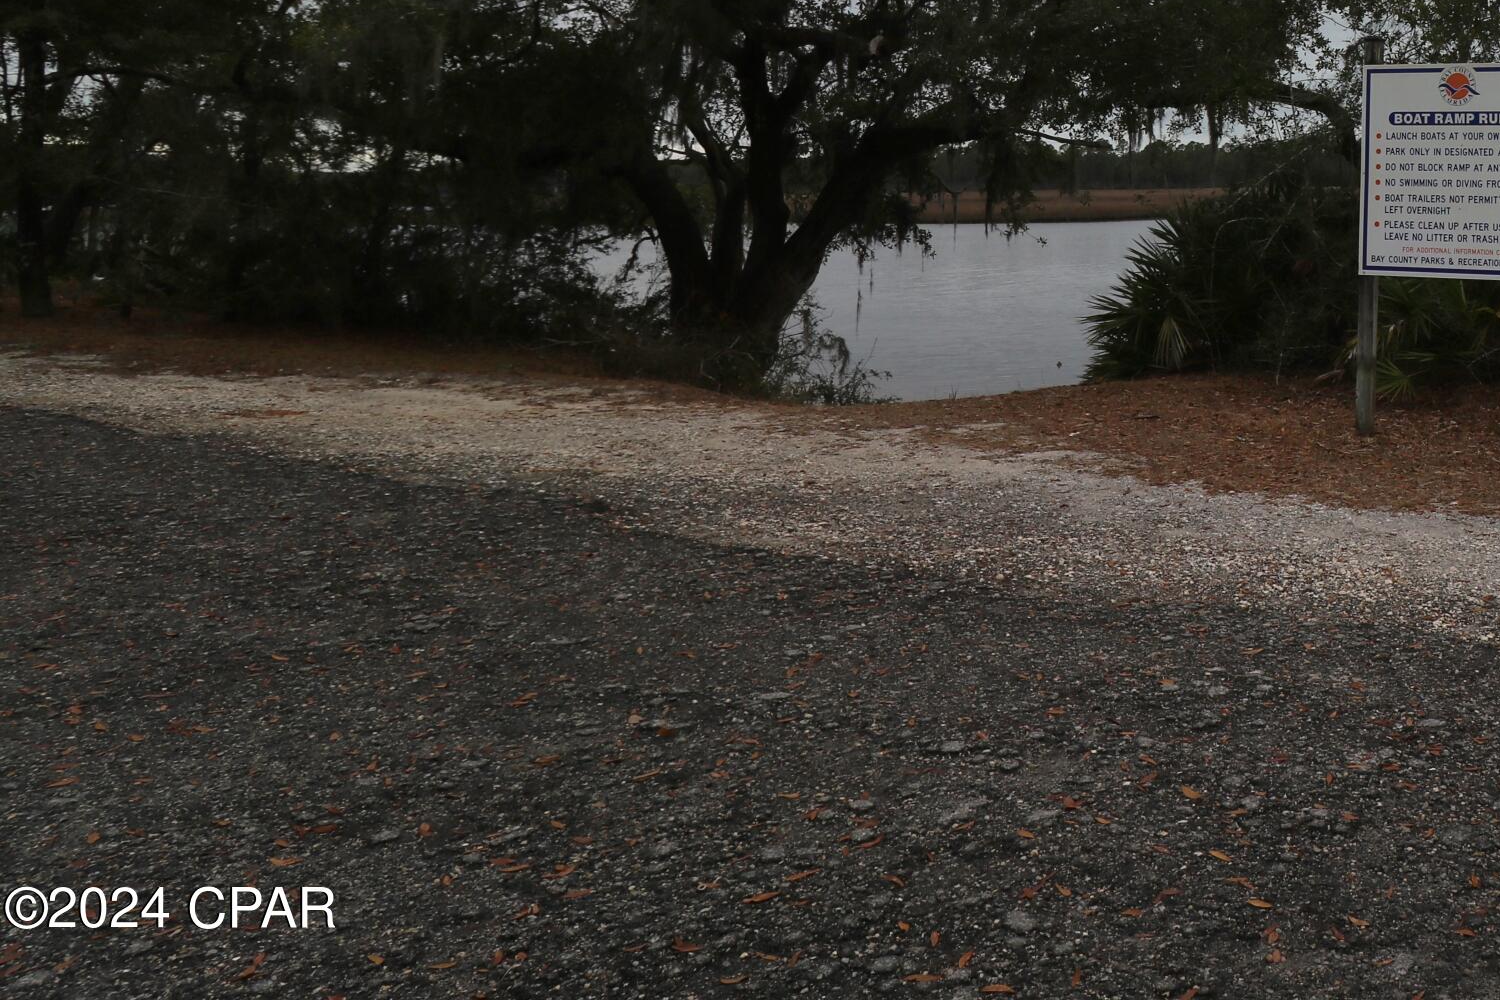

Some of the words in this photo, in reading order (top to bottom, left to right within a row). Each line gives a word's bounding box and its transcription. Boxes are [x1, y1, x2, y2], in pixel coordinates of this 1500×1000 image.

[1394, 113, 1430, 124] BOAT
[1434, 113, 1474, 124] RAMP
[1386, 132, 1417, 141] LAUNCH
[1421, 132, 1445, 141] BOATS
[1449, 132, 1458, 141] AT
[1462, 132, 1484, 141] YOUR
[1385, 147, 1406, 156] PARK
[1409, 147, 1430, 156] ONLY
[1433, 148, 1441, 156] IN
[1445, 148, 1494, 156] DESIGNATED
[1385, 163, 1396, 171] DO
[1399, 163, 1415, 172] NOT
[1418, 163, 1444, 172] BLOCK
[1447, 163, 1470, 172] RAMP
[1473, 163, 1484, 172] AT
[1385, 179, 1396, 188] NO
[1399, 179, 1438, 188] SWIMMING
[1441, 179, 1453, 188] OR
[1456, 180, 1483, 188] DIVING
[1385, 194, 1404, 203] BOAT
[1408, 194, 1446, 203] TRAILERS
[1449, 195, 1465, 204] NOT
[1384, 206, 1404, 214] LEFT
[1407, 206, 1451, 215] OVERNIGHT
[1384, 221, 1415, 230] PLEASE
[1418, 221, 1444, 230] CLEAN
[1448, 222, 1459, 231] UP
[1462, 222, 1489, 231] AFTER
[1384, 232, 1409, 241] LEAVE
[1412, 232, 1423, 242] NO
[1426, 233, 1453, 242] LITTER
[1457, 234, 1468, 243] OR
[1471, 234, 1499, 244] TRASH
[1402, 246, 1413, 254] FOR
[1371, 255, 1385, 263] BAY
[1388, 256, 1418, 264] COUNTY
[1421, 257, 1445, 265] PARKS
[1448, 257, 1454, 266] &
